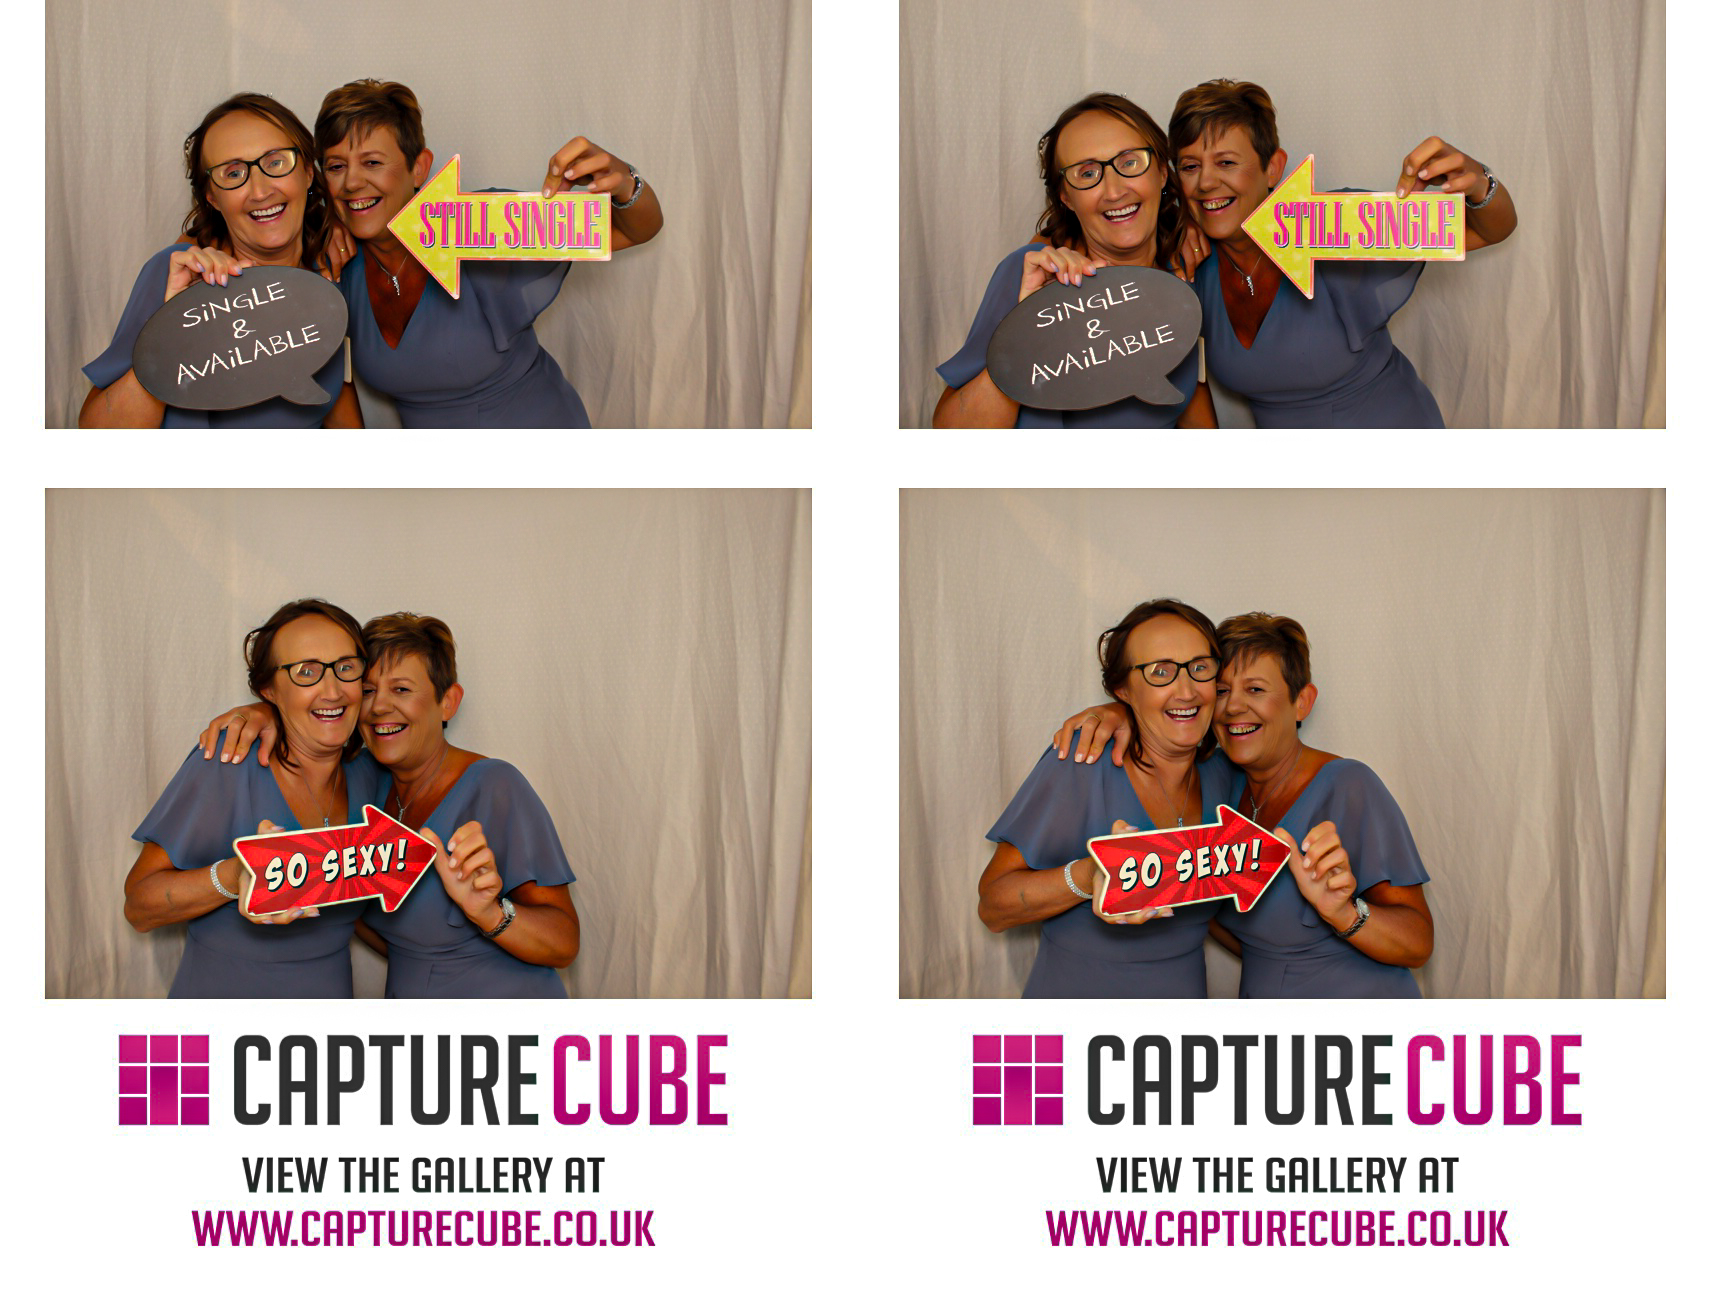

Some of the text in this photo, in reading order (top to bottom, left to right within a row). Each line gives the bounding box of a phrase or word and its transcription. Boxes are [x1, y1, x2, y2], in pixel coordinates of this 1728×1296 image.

[419, 201, 601, 249] STILL SINGLE
[1273, 201, 1455, 249] STILL SINGLE
[232, 318, 256, 339] &
[1086, 318, 1110, 339] &
[264, 838, 408, 892] SO SEXY!
[1118, 838, 1262, 892] SO SEXY!
